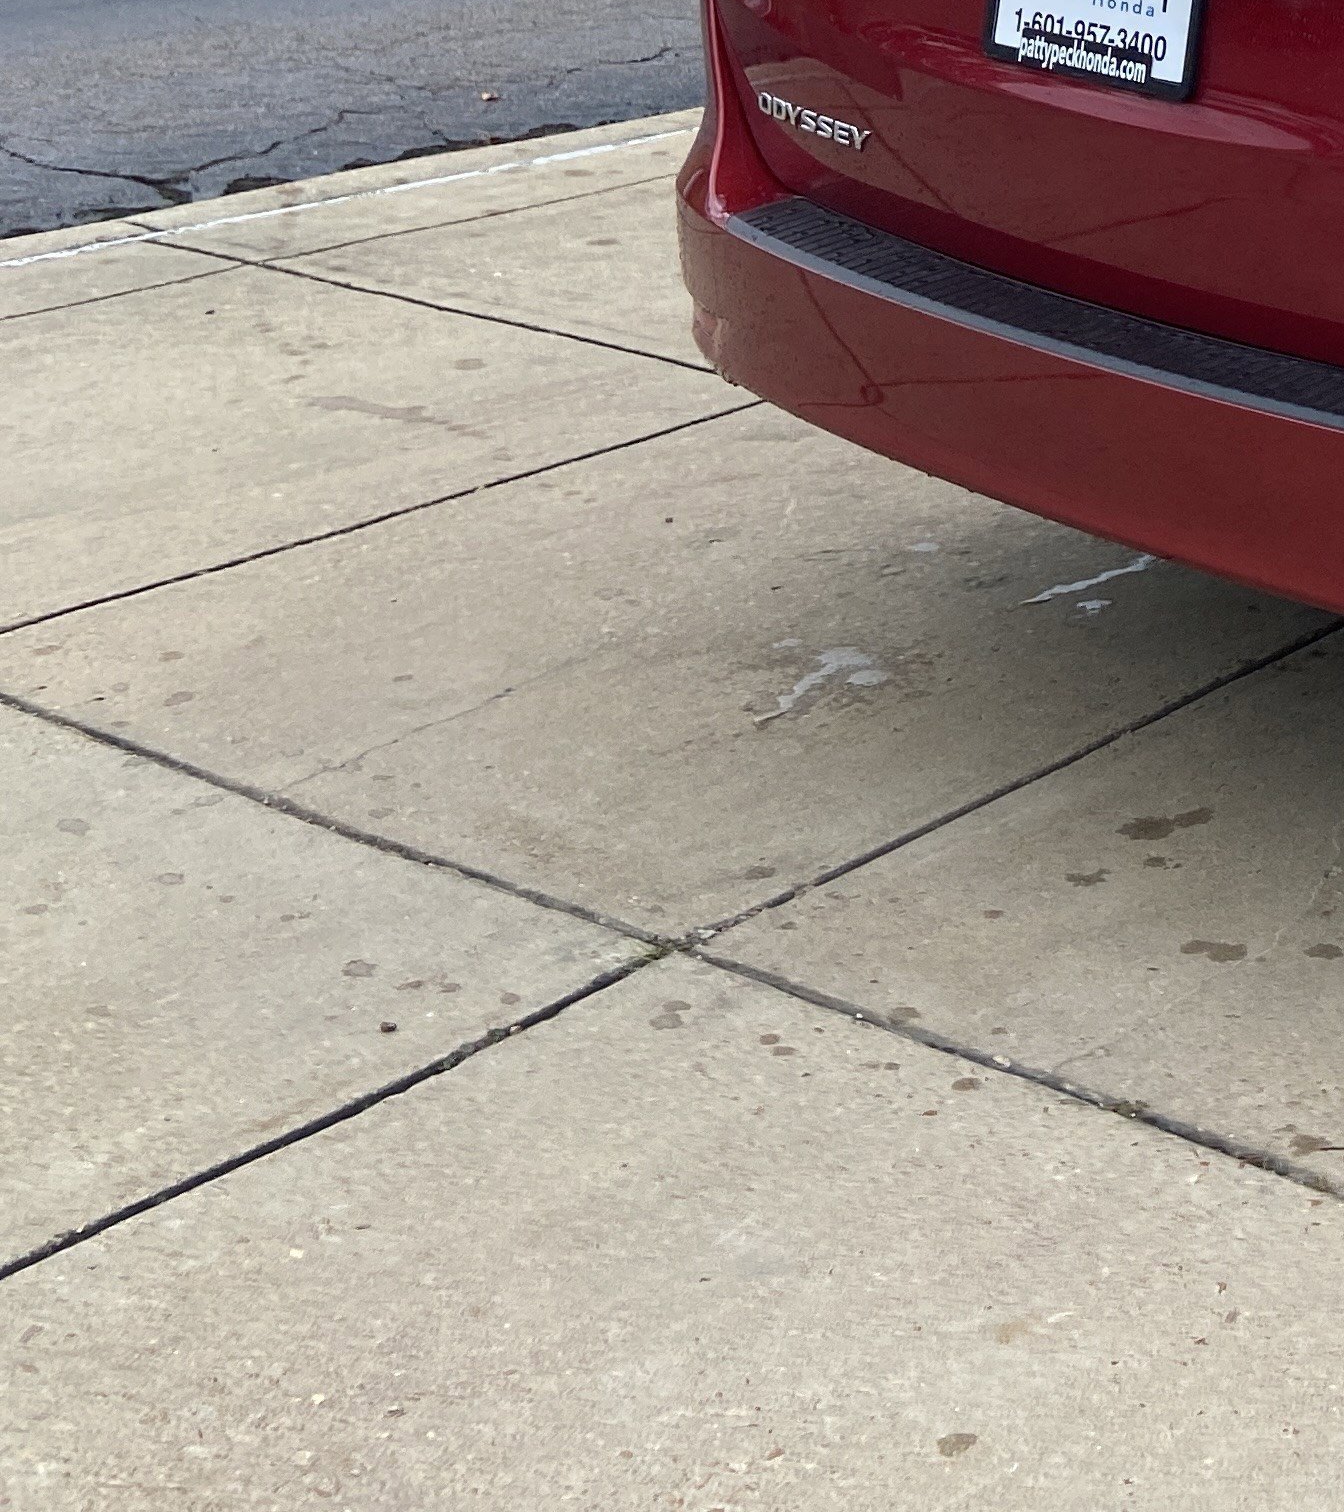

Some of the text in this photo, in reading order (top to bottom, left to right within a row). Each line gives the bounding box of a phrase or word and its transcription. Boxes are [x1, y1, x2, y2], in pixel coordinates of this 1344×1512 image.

[1015, 8, 1167, 62] 1-601-957-3400
[1017, 33, 1147, 84] pattypeckhonda.com
[758, 91, 873, 150] ODYSSEY
